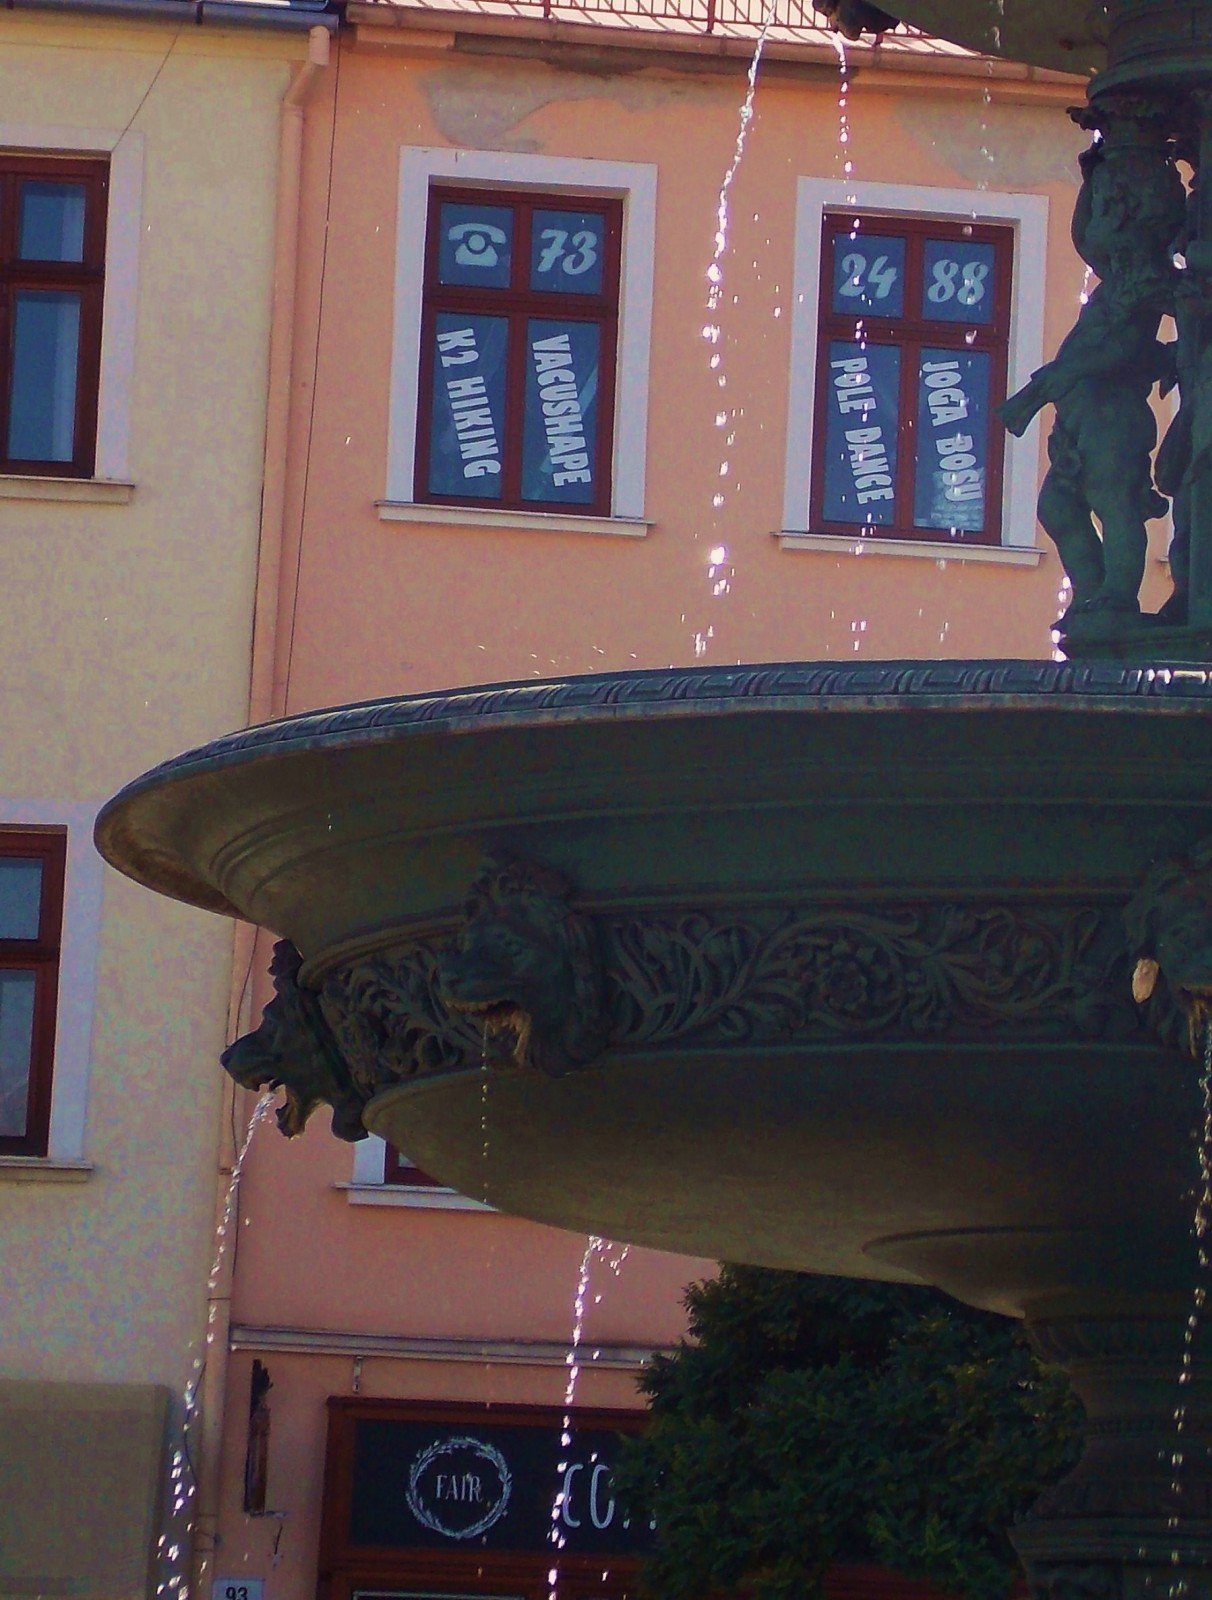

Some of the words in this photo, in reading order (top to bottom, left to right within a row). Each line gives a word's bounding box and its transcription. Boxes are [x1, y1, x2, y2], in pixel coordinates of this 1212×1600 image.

[537, 228, 598, 276] 73
[838, 253, 898, 300] 24
[927, 259, 989, 304] 88
[437, 328, 480, 369] K2
[531, 333, 592, 487] VACUSHAPE
[830, 356, 877, 415] POLE
[921, 360, 969, 427] JOGA
[446, 375, 501, 479] HIKING
[844, 425, 895, 505] DANCE
[935, 434, 983, 503] BOSU
[435, 1473, 484, 1504] FAIR
